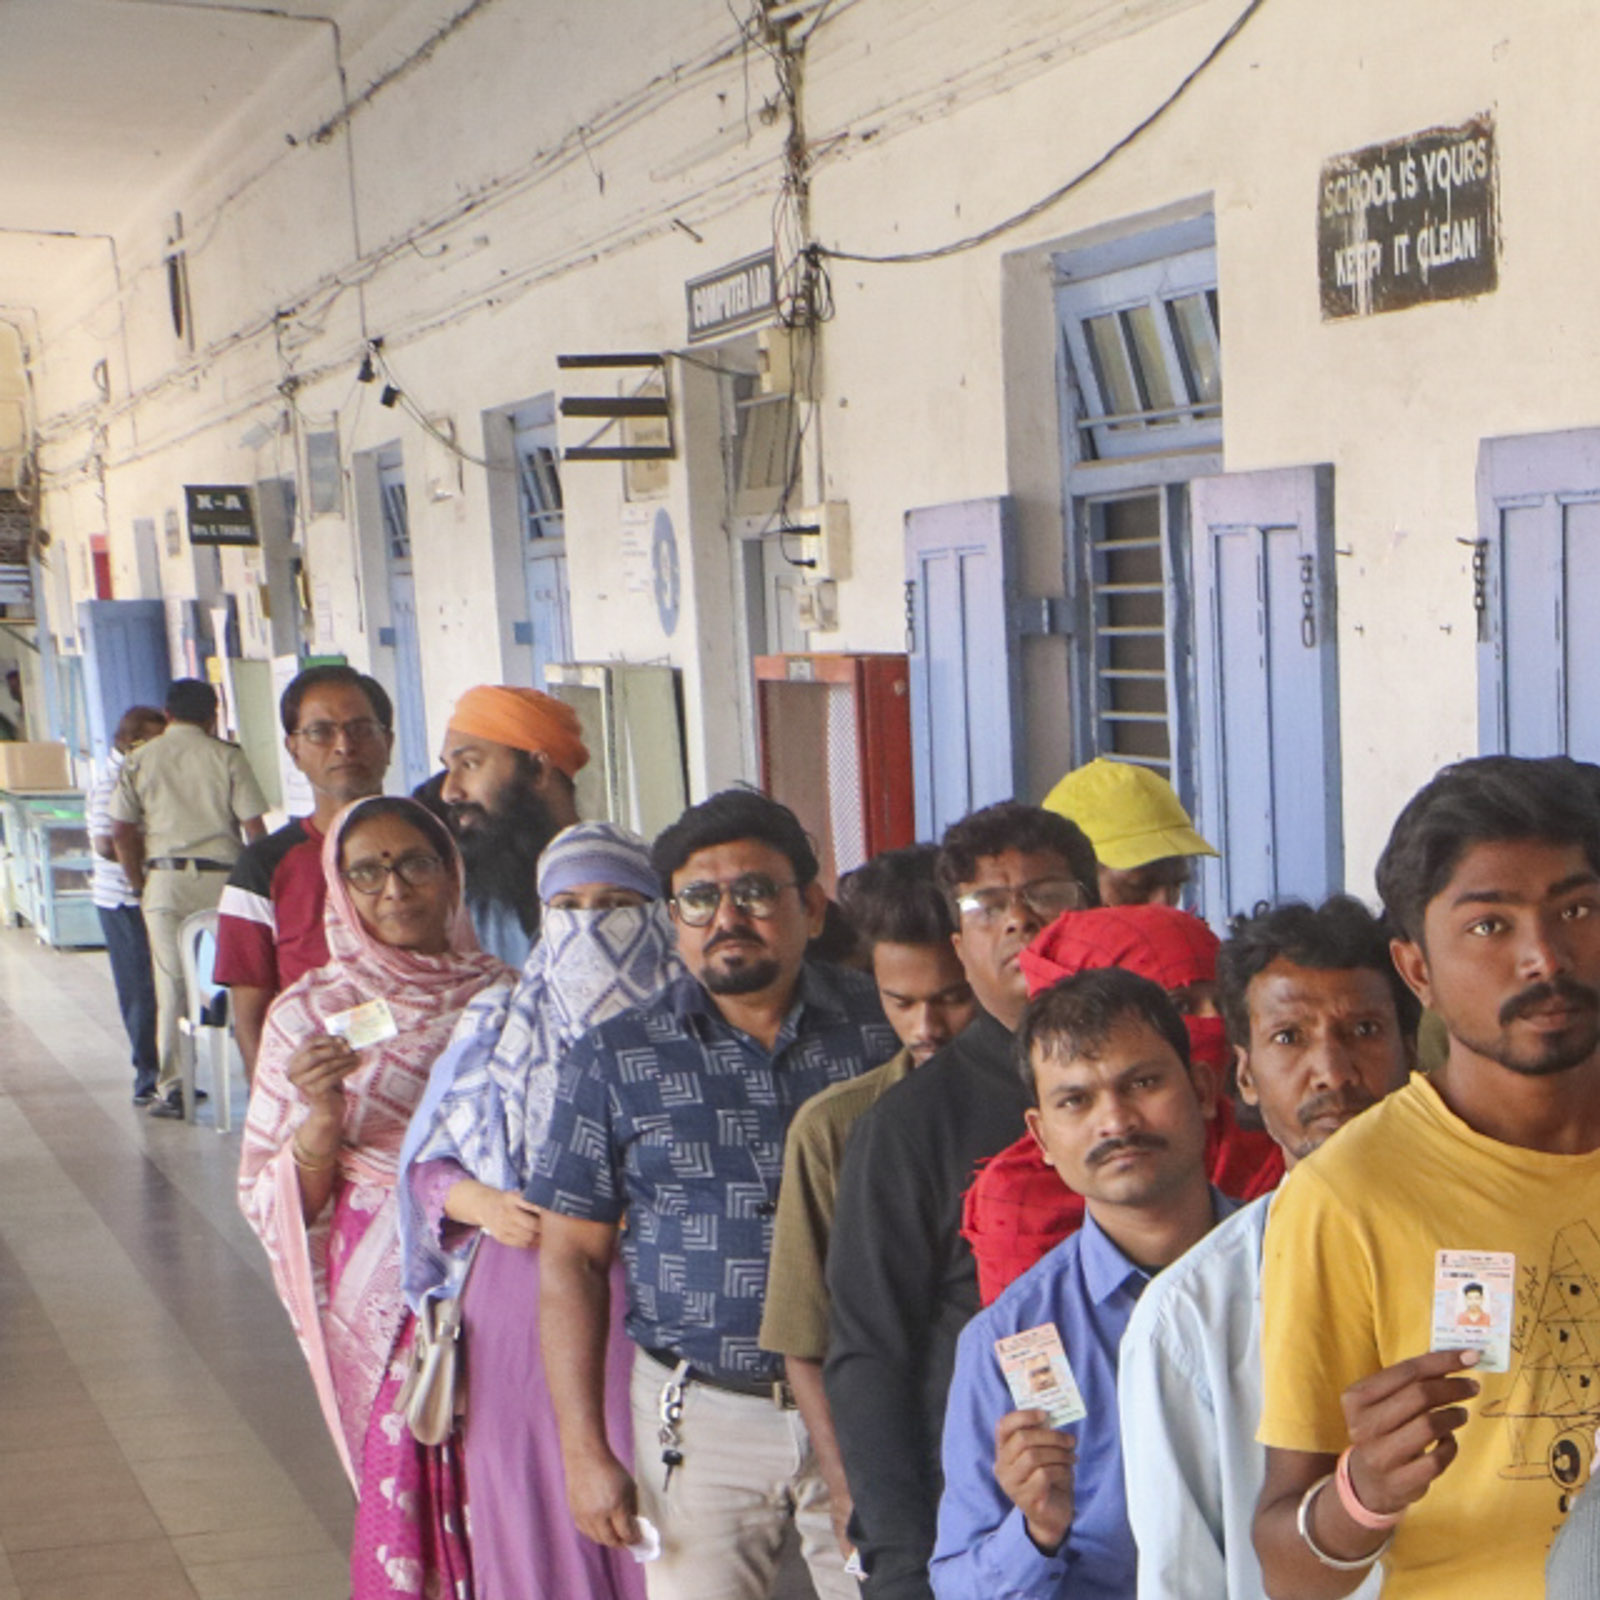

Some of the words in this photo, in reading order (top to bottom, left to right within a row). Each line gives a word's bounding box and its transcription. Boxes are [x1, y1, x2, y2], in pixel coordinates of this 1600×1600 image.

[1323, 165, 1396, 218] SCHOOL
[1400, 157, 1416, 199] IS
[1422, 138, 1487, 192] YOURS
[1335, 240, 1382, 287] KEEP
[1394, 233, 1409, 276] IT
[1417, 217, 1476, 272] CLEAN
